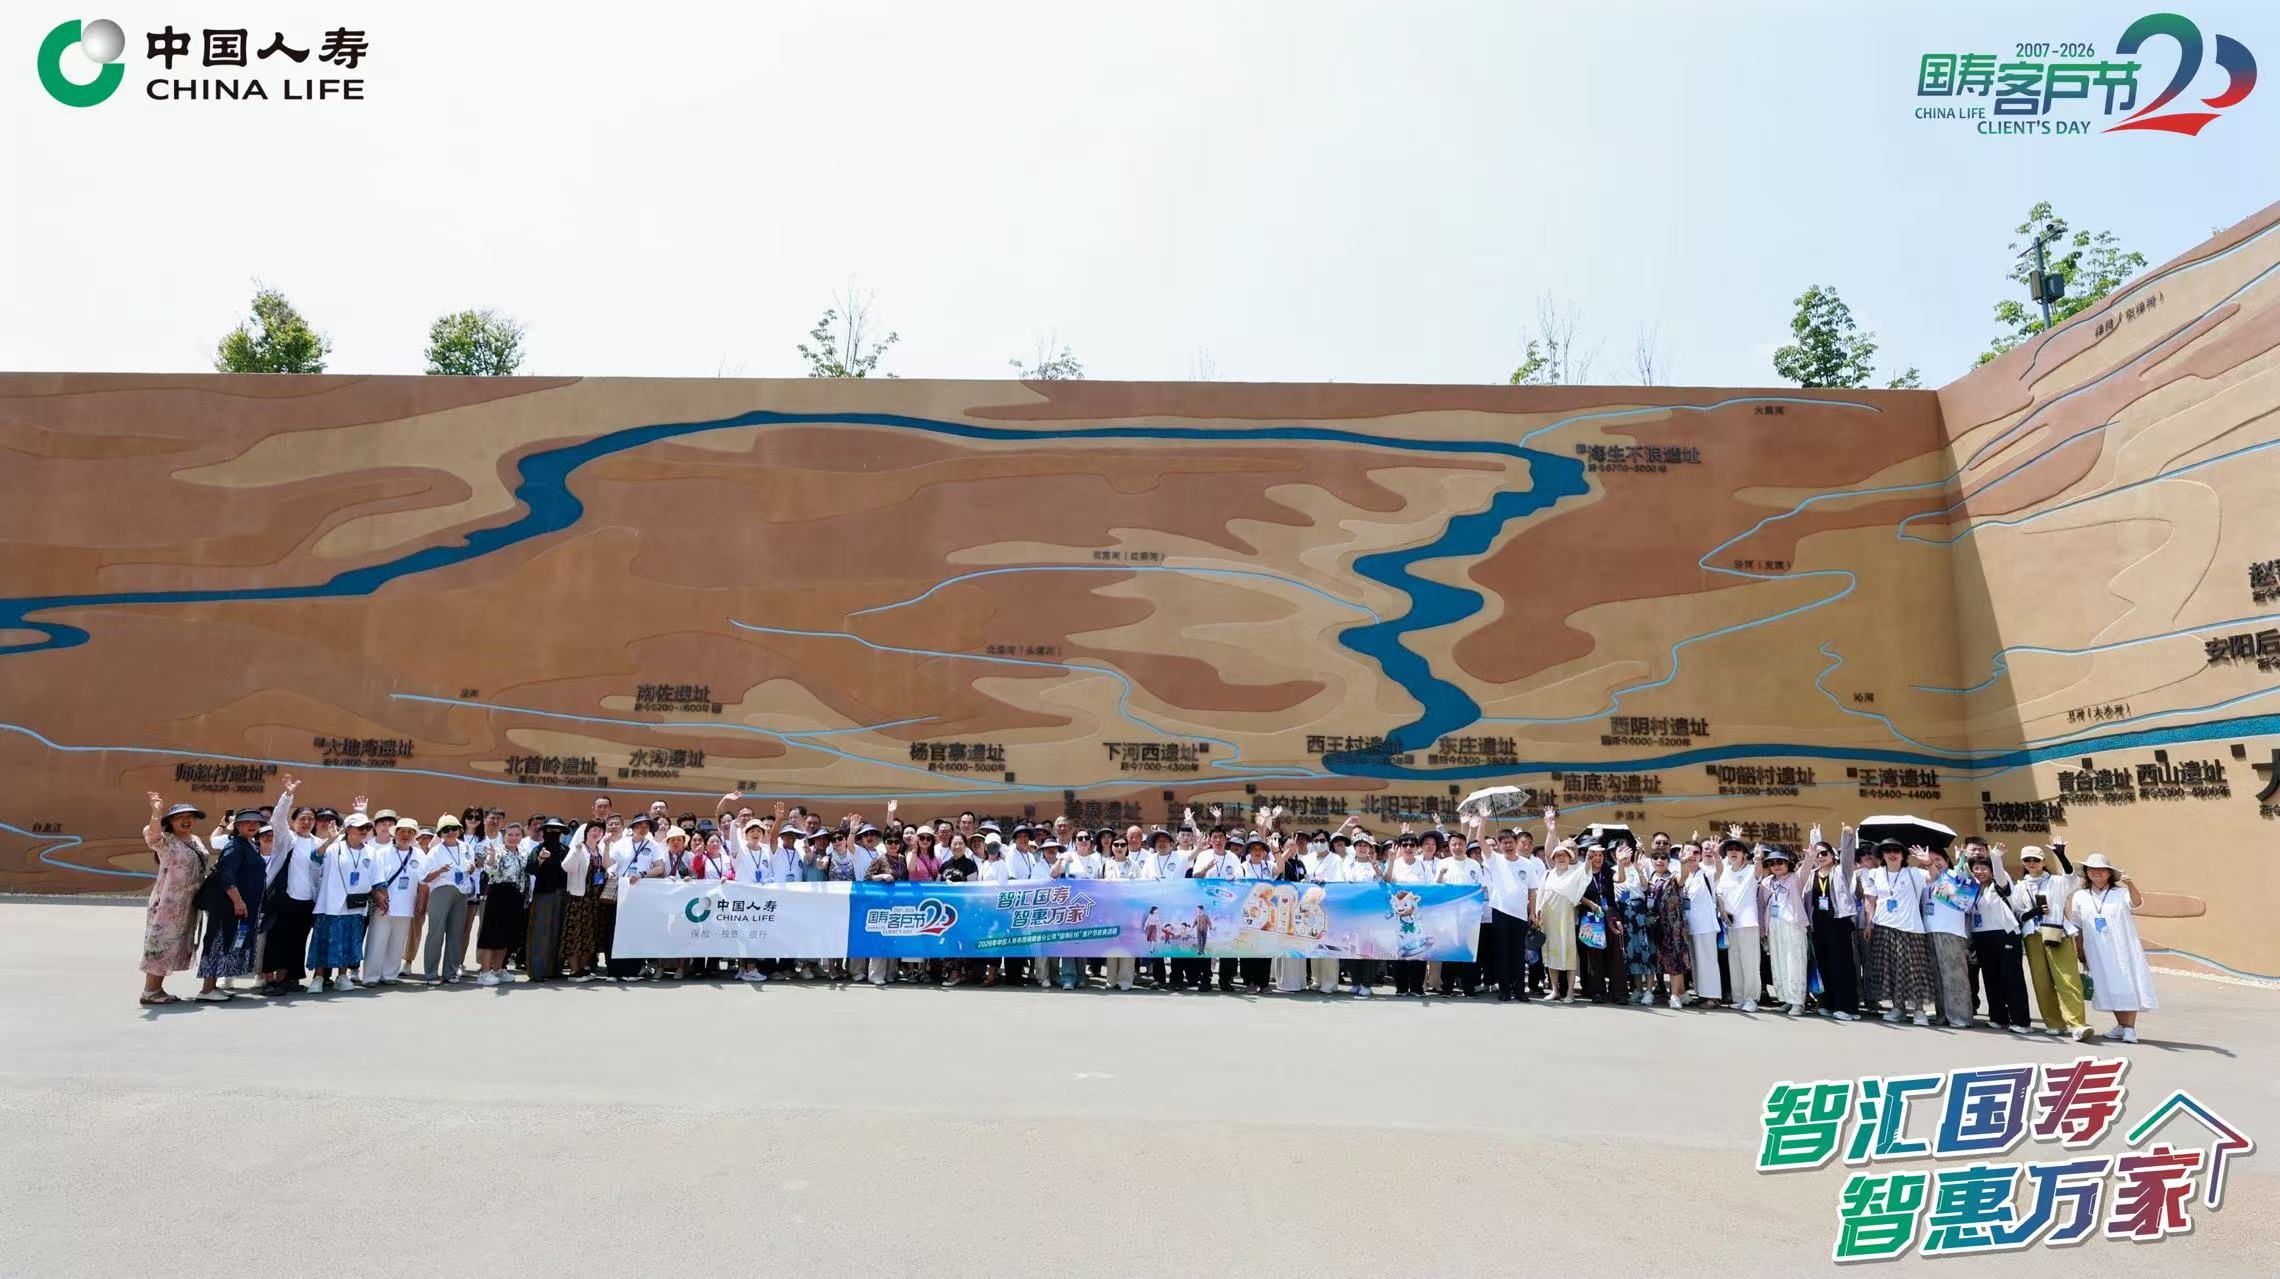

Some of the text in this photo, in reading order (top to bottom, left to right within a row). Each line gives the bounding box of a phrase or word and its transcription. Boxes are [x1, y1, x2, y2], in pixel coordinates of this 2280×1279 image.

[2248, 559, 2280, 589] 赵
[637, 684, 711, 703] 南佐遗址
[1610, 717, 1710, 736] 西阴村遗址
[323, 738, 414, 758] 大地湾遗址
[910, 742, 1005, 761] 杨官寨遗址
[1103, 742, 1199, 761] 下河西遗址
[1438, 736, 1518, 756] 东庄遗址
[504, 756, 598, 775] 北首岭遗址
[629, 749, 704, 768] 水沟遗址
[1718, 766, 1816, 786] 仰韶村遗址
[1859, 768, 1940, 788] 王湾遗址
[2057, 767, 2135, 793] 青台遗址
[2136, 758, 2229, 788] 西山遗址
[1564, 774, 1662, 794] 庙底沟遗址
[717, 899, 777, 912] 中国人寿
[997, 886, 1070, 909] 智汇国寿
[716, 914, 775, 922] CHINA LIFE
[868, 911, 926, 928] 国寿客户节
[1012, 905, 1086, 928] 智惠万家
